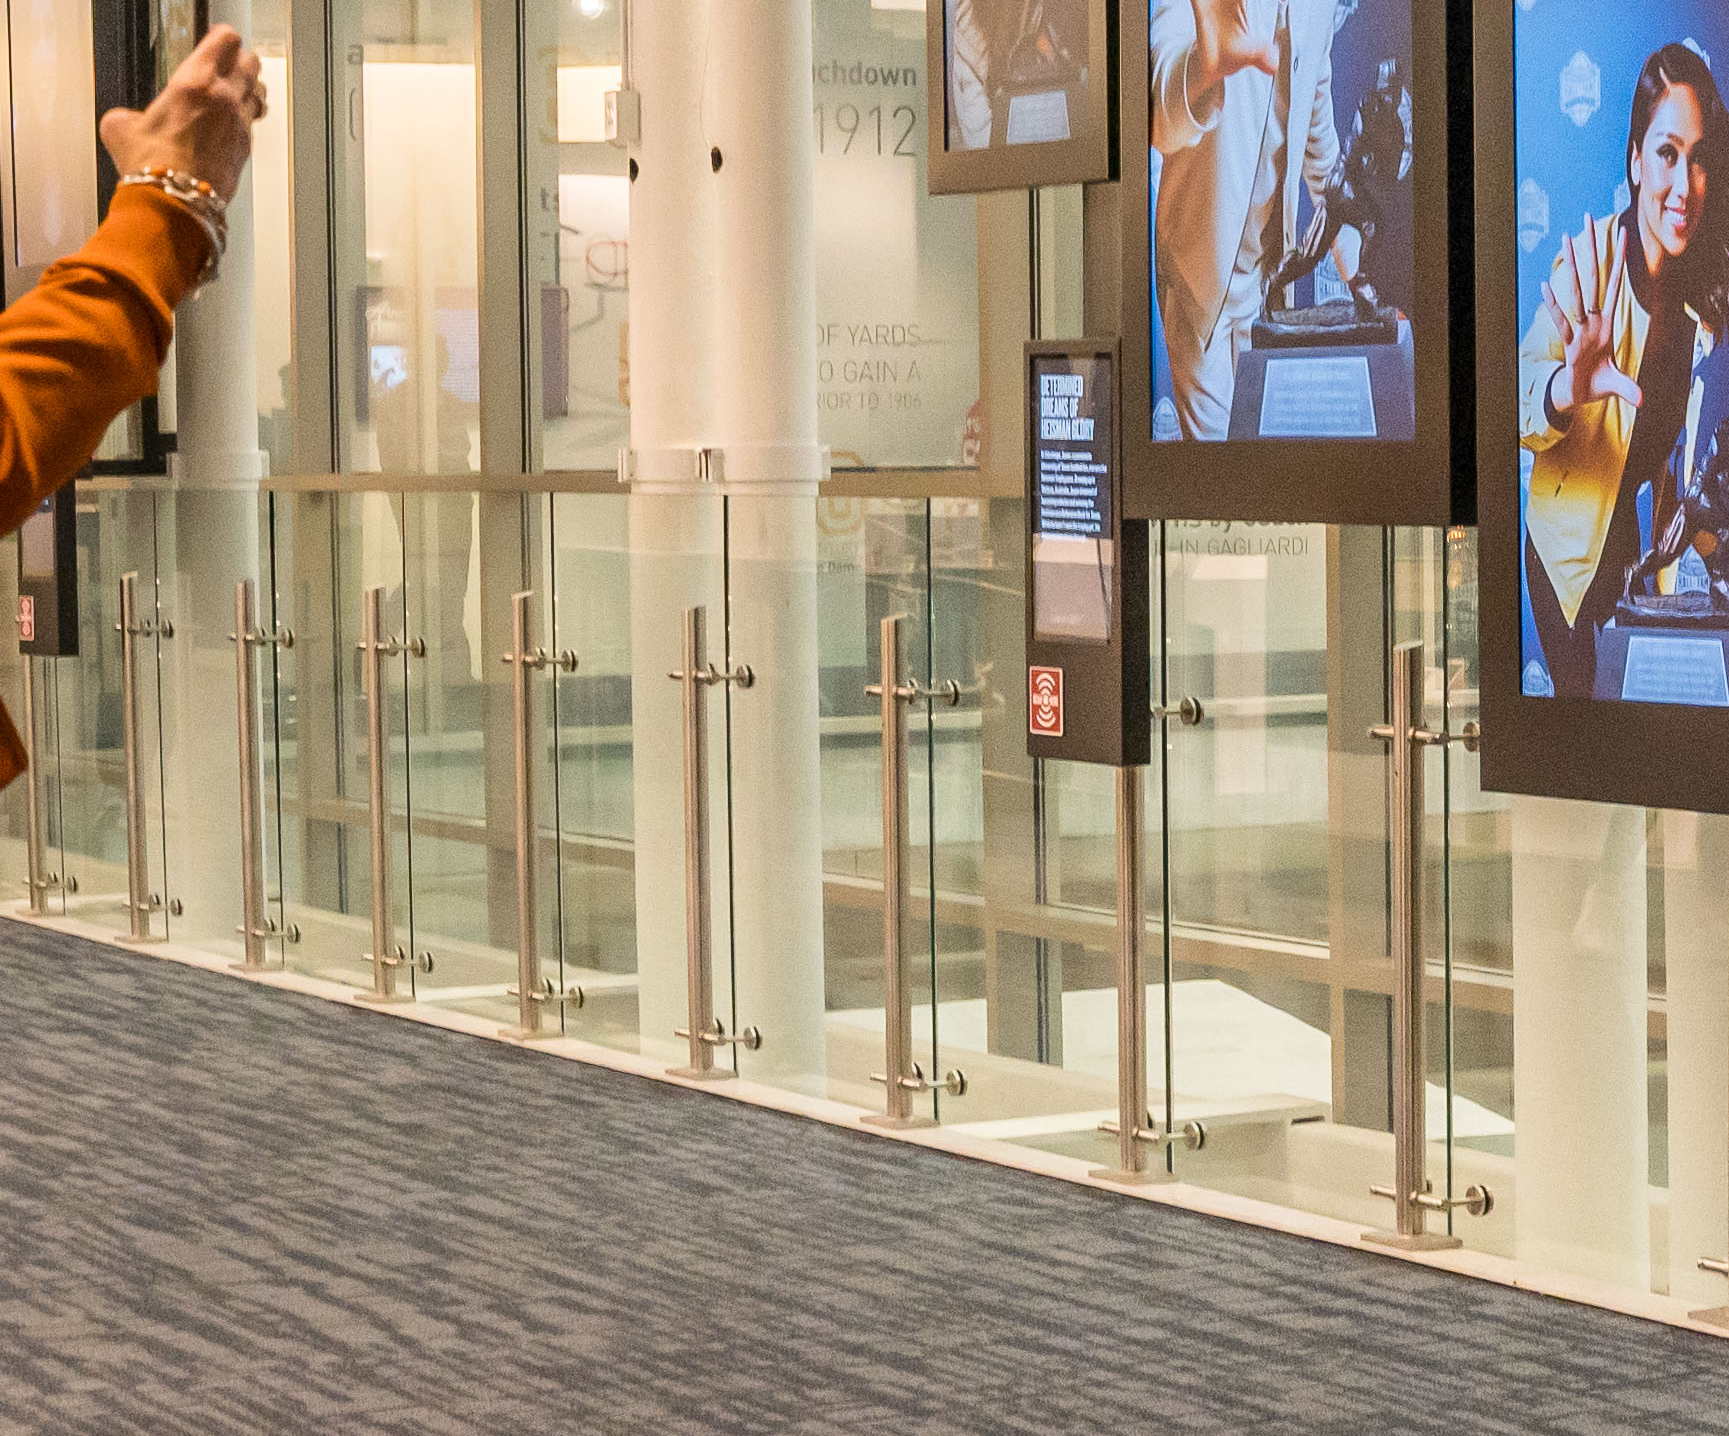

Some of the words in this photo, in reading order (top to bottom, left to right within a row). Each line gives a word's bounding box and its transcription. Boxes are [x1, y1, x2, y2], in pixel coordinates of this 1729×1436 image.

[812, 59, 918, 86] chdown
[813, 104, 918, 157] 1912
[847, 324, 921, 347] YARDS
[843, 360, 898, 384] GAIN
[906, 360, 922, 383] A
[1040, 397, 1069, 418] DREAMS
[1207, 536, 1310, 556] GAGLIARDI
